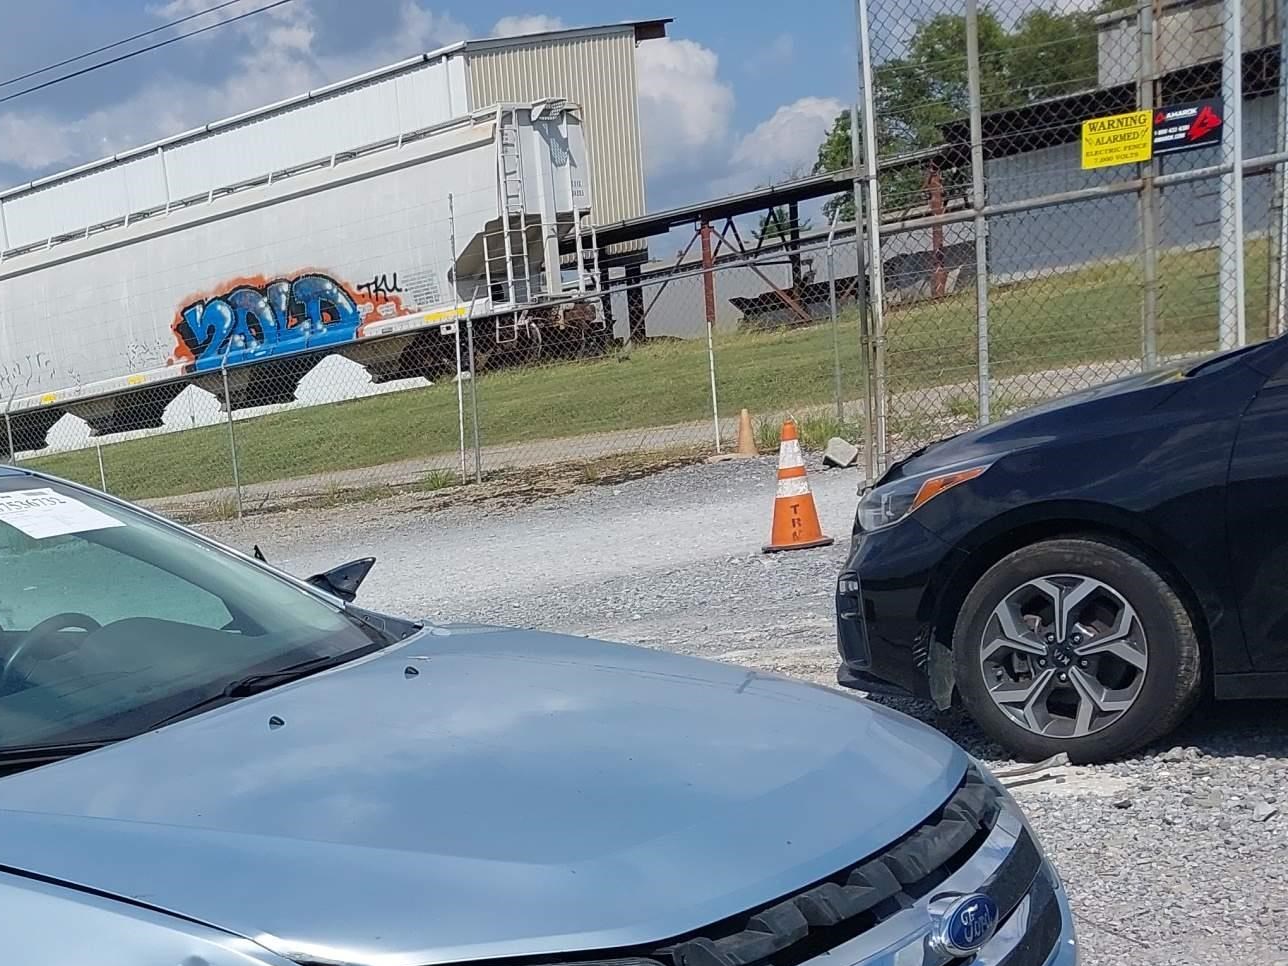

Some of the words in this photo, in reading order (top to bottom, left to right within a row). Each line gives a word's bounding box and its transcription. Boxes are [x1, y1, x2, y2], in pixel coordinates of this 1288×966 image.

[1088, 113, 1147, 132] WARNING
[1094, 131, 1140, 147] ALARMED
[1085, 146, 1121, 157] ELECTRIC
[1123, 142, 1148, 151] FENCE
[1115, 151, 1139, 160] VOLTS
[960, 902, 992, 943] Ford
